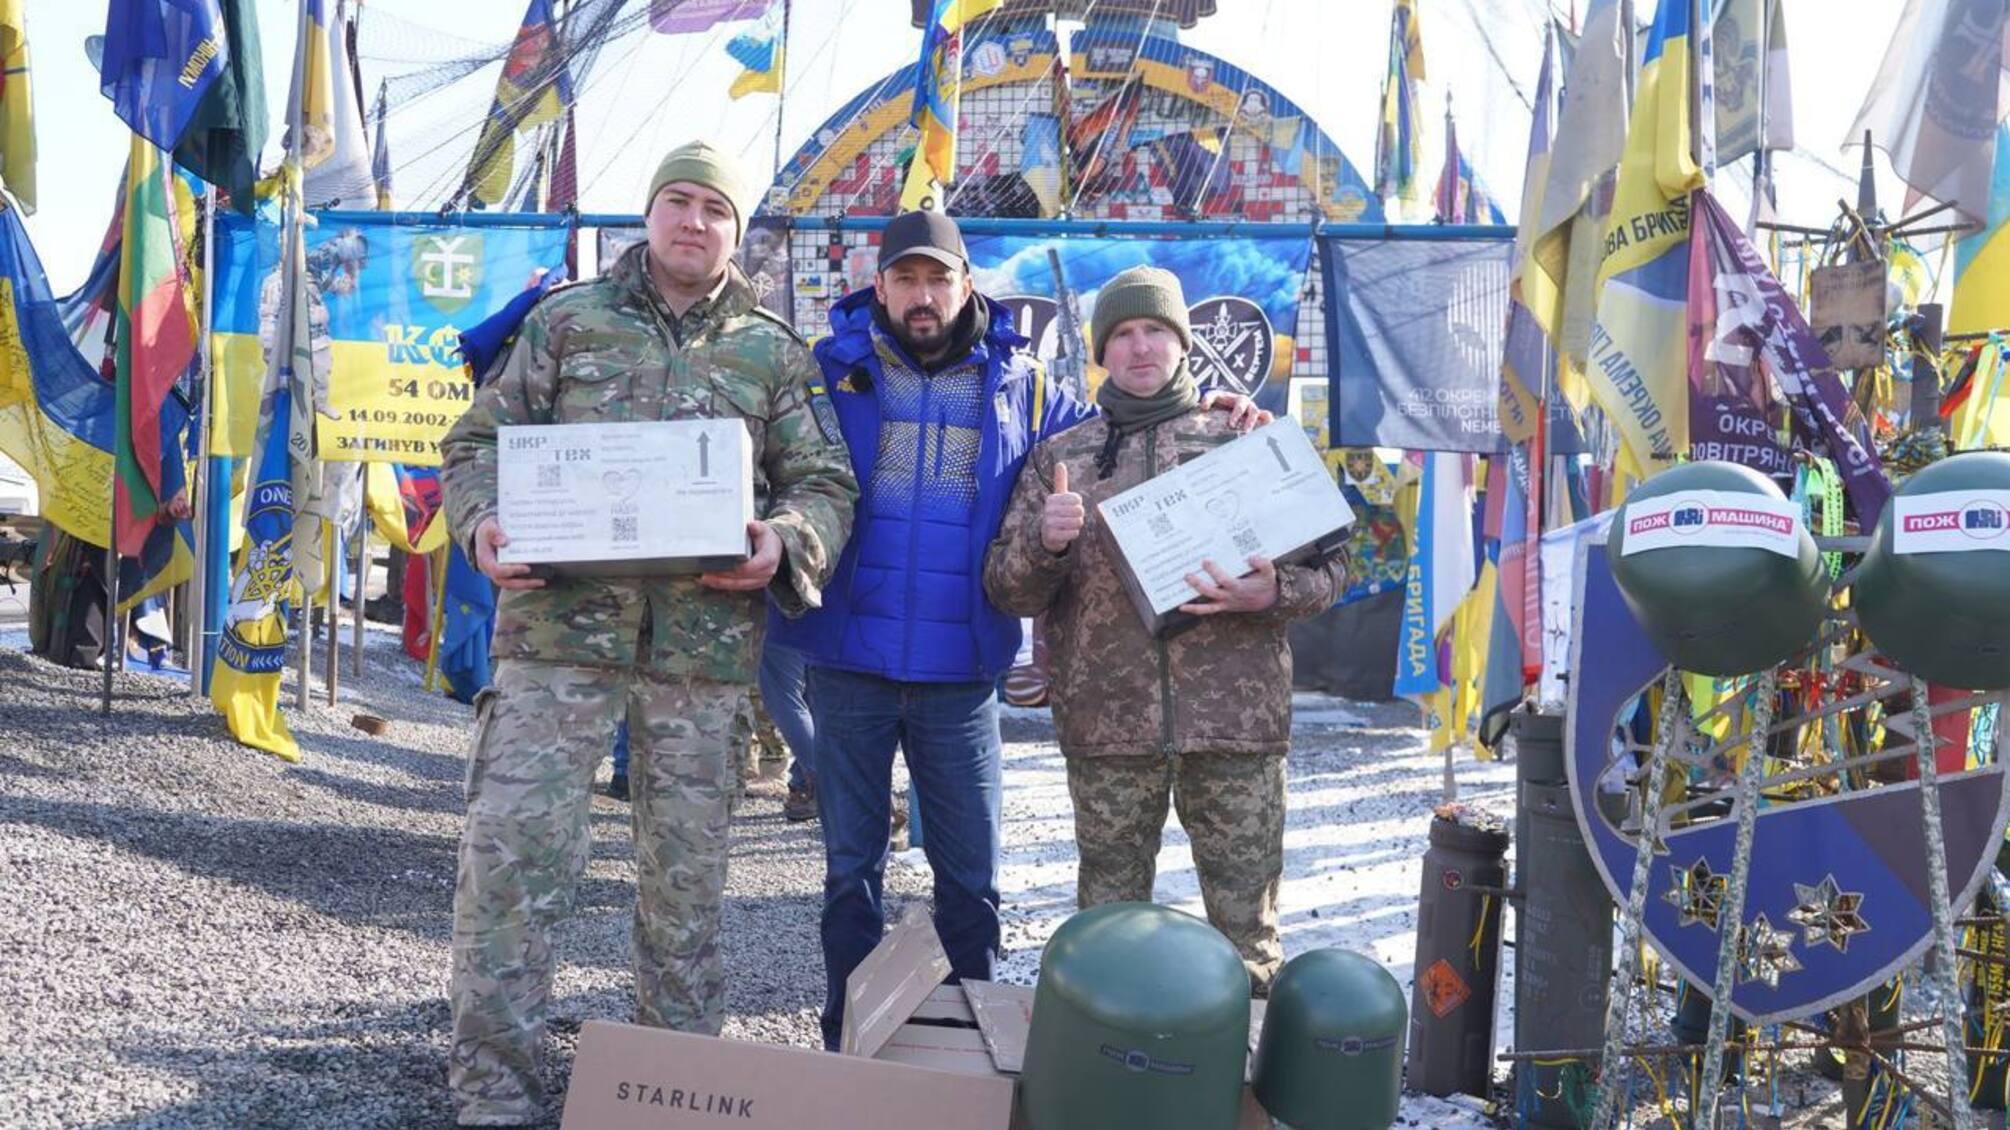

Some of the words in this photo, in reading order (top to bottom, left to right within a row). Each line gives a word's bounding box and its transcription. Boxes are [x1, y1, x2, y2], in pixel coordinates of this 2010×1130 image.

[388, 379, 419, 399] 54
[336, 436, 428, 454] ЗАГИНУВ
[1633, 513, 1668, 533] ПОЖ
[1711, 510, 1788, 531] МАШИНА
[1909, 514, 1956, 530] ПОЖ
[1407, 564, 1427, 678] БРИГАДА
[616, 1081, 755, 1119] STARLINK
